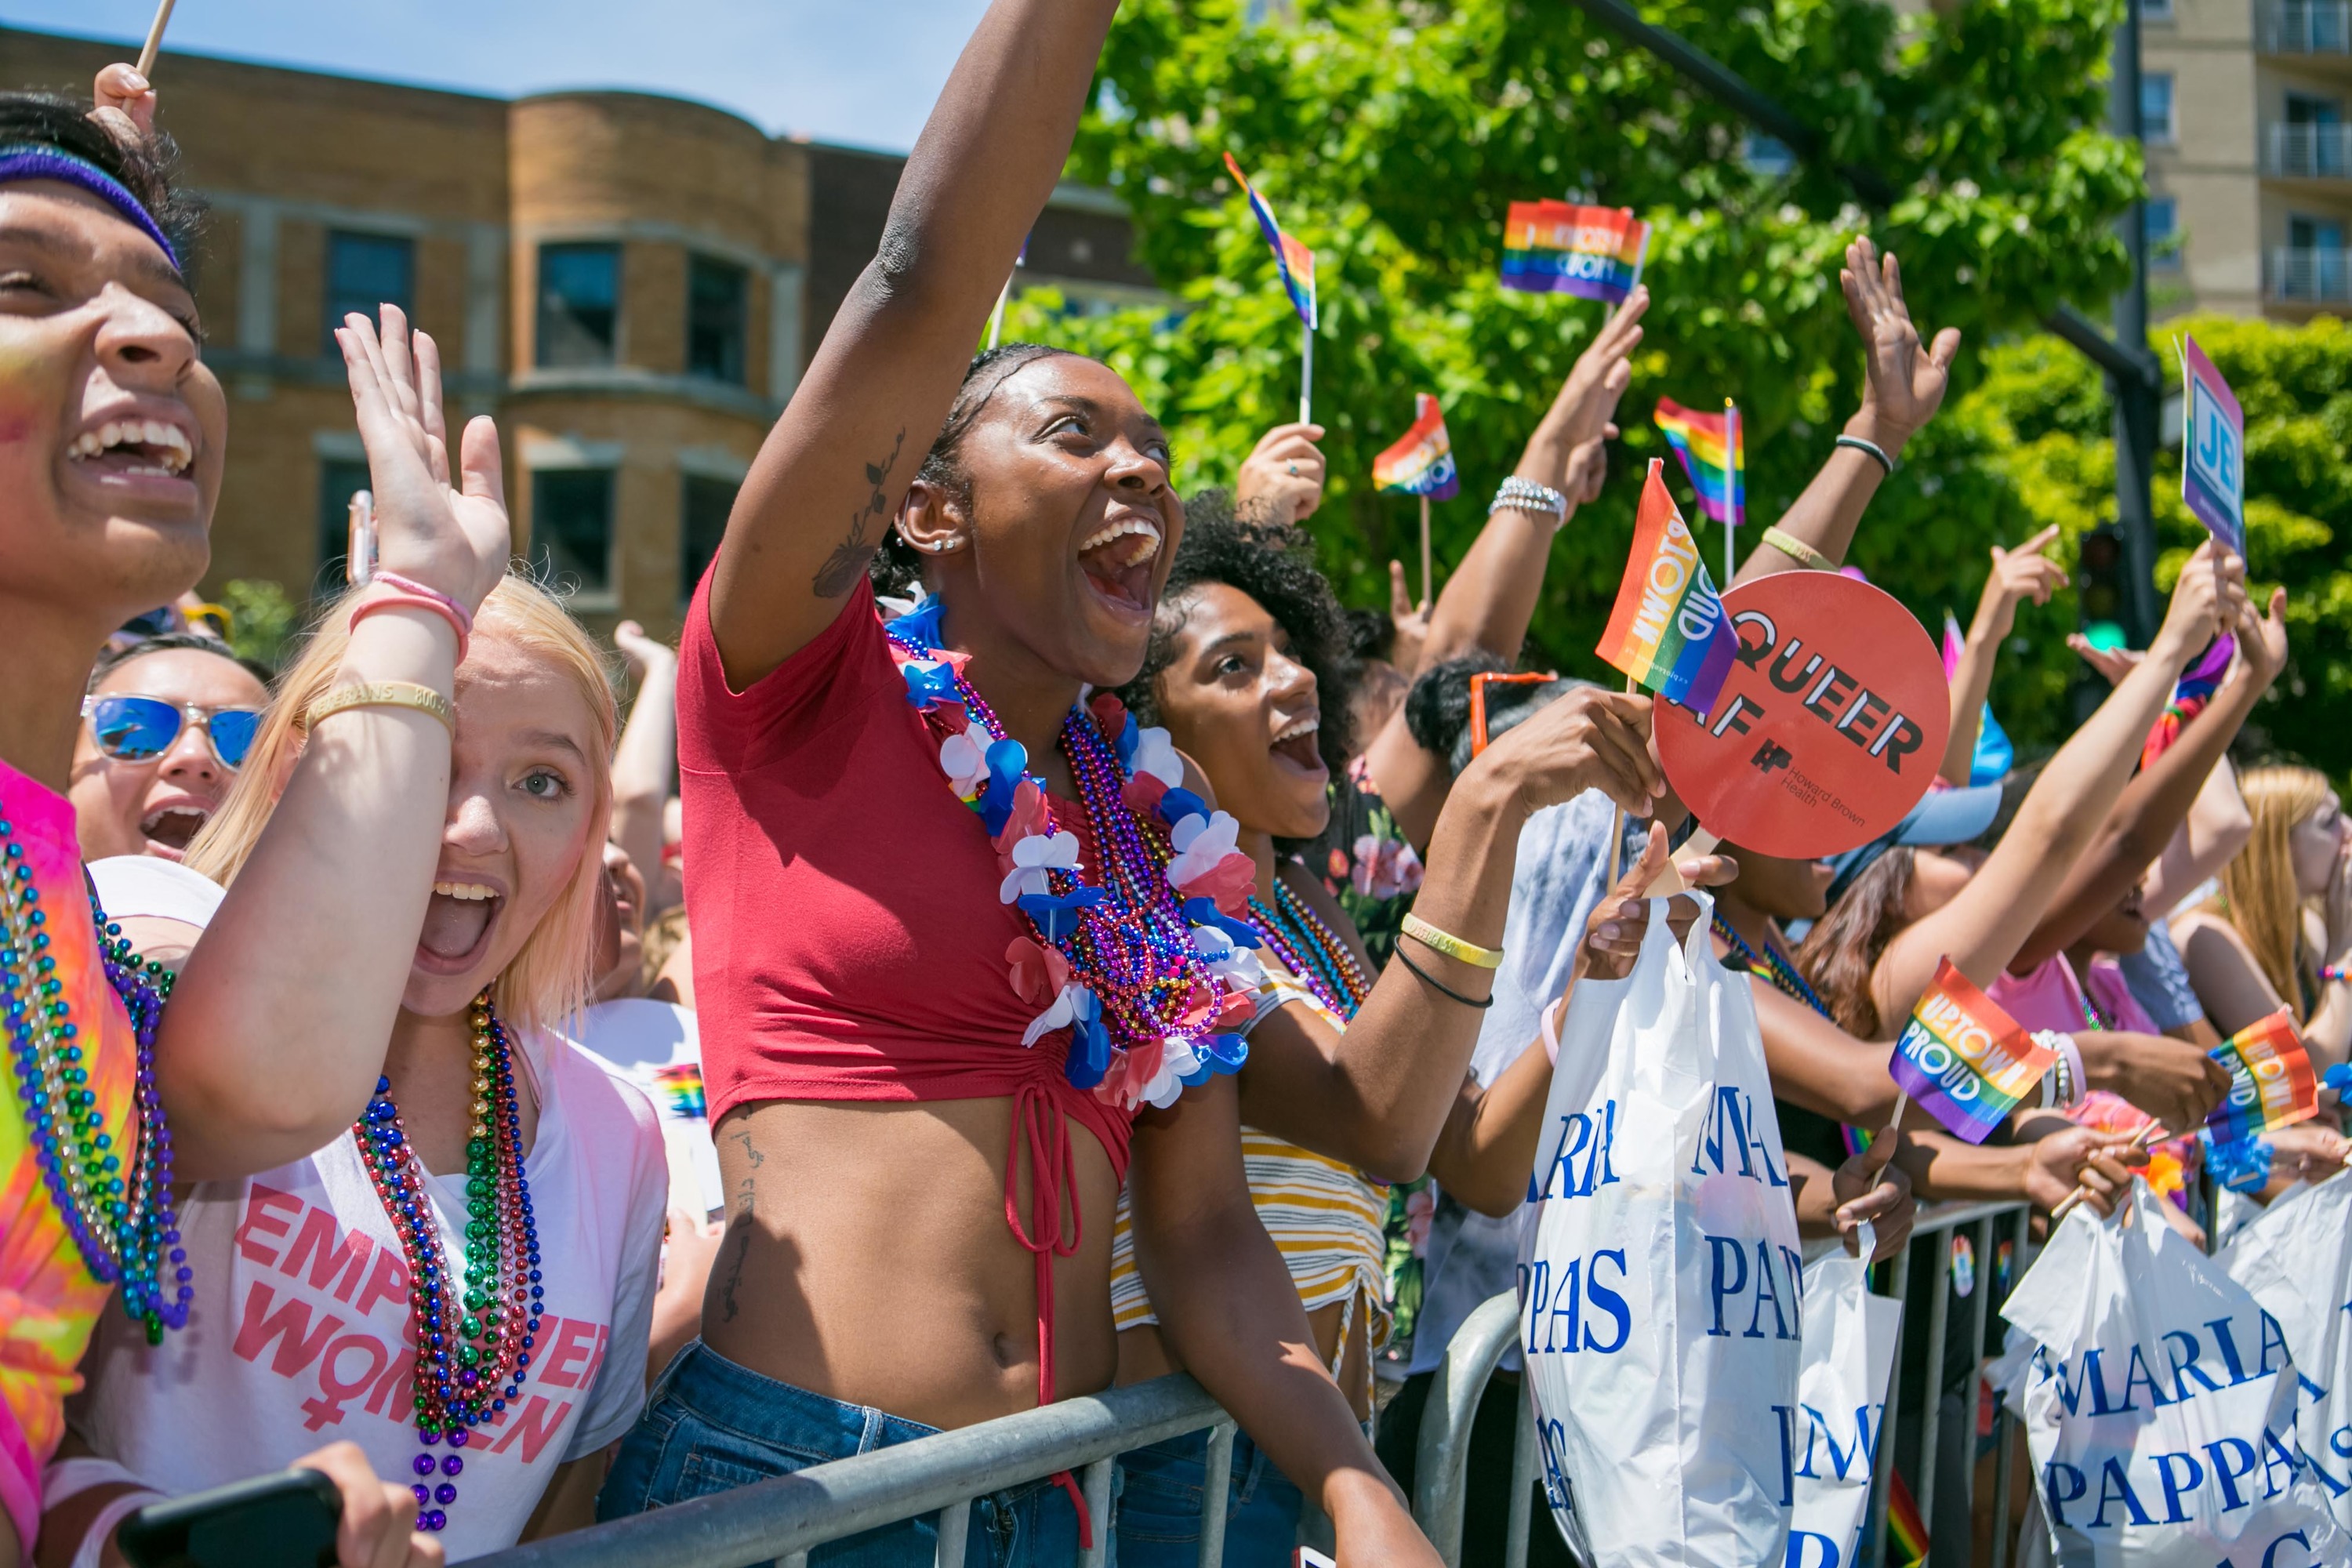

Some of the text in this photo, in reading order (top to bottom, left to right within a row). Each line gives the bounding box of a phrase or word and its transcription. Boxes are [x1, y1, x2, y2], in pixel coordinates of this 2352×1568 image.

[312, 684, 394, 719] VETERANS
[1730, 609, 1923, 775] QUEER
[1780, 776, 1818, 808] Health
[1788, 766, 1866, 828] Howard Brown
[1899, 1019, 1981, 1102] PROUD
[1922, 993, 2027, 1089] UPTOWN
[235, 1183, 609, 1392] EMPER
[2054, 1308, 2294, 1420] MARIA
